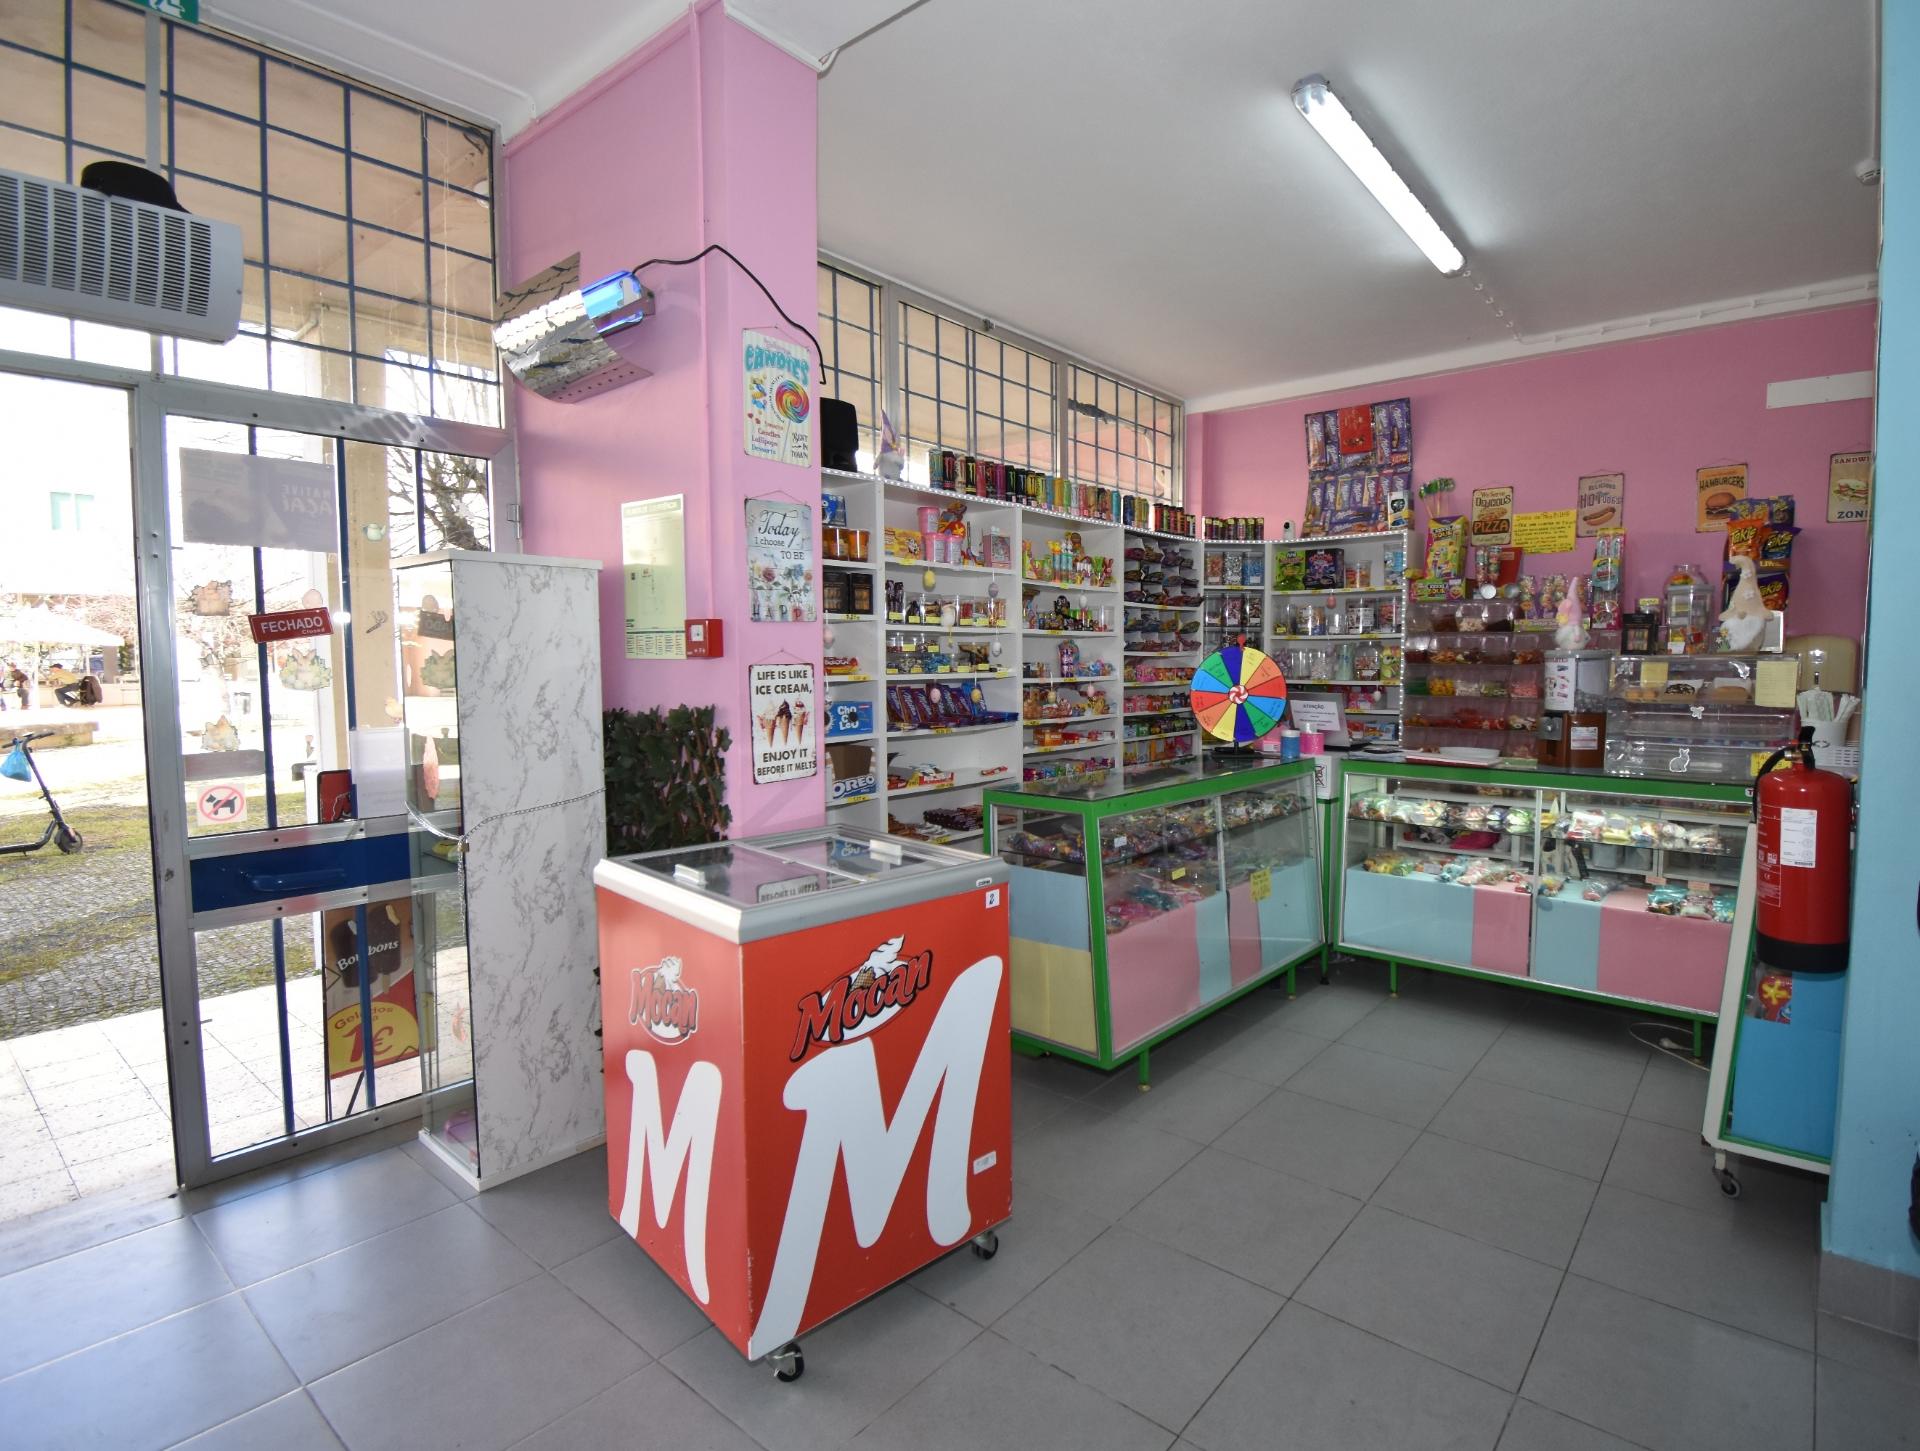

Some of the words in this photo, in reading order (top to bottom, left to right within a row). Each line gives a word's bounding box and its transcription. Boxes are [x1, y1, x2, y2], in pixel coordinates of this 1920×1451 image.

[745, 343, 810, 386] CANDIES
[1699, 475, 1745, 492] HAMBURGERS
[758, 509, 800, 548] Today
[1473, 519, 1510, 533] PIZZA
[760, 537, 786, 547] choose
[780, 550, 791, 559] TO
[794, 551, 805, 560] BE
[260, 616, 323, 633] FECHADO
[757, 671, 776, 681] LIFE
[778, 670, 787, 680] IS
[789, 670, 808, 679] LIKE
[755, 684, 772, 695] ICE
[774, 683, 812, 694] CREAM,
[763, 749, 797, 763] ENJOY
[800, 748, 808, 759] IT
[757, 765, 785, 776] BEFORE
[787, 763, 793, 772] IT
[795, 760, 817, 772] MELTS
[832, 775, 875, 798] OREO
[337, 939, 400, 971] Bobons
[631, 970, 698, 1036] Mocan
[790, 949, 933, 1063] Mocan
[334, 1005, 394, 1031] Geldos
[750, 955, 1004, 1361] M
[619, 1049, 723, 1305] M
